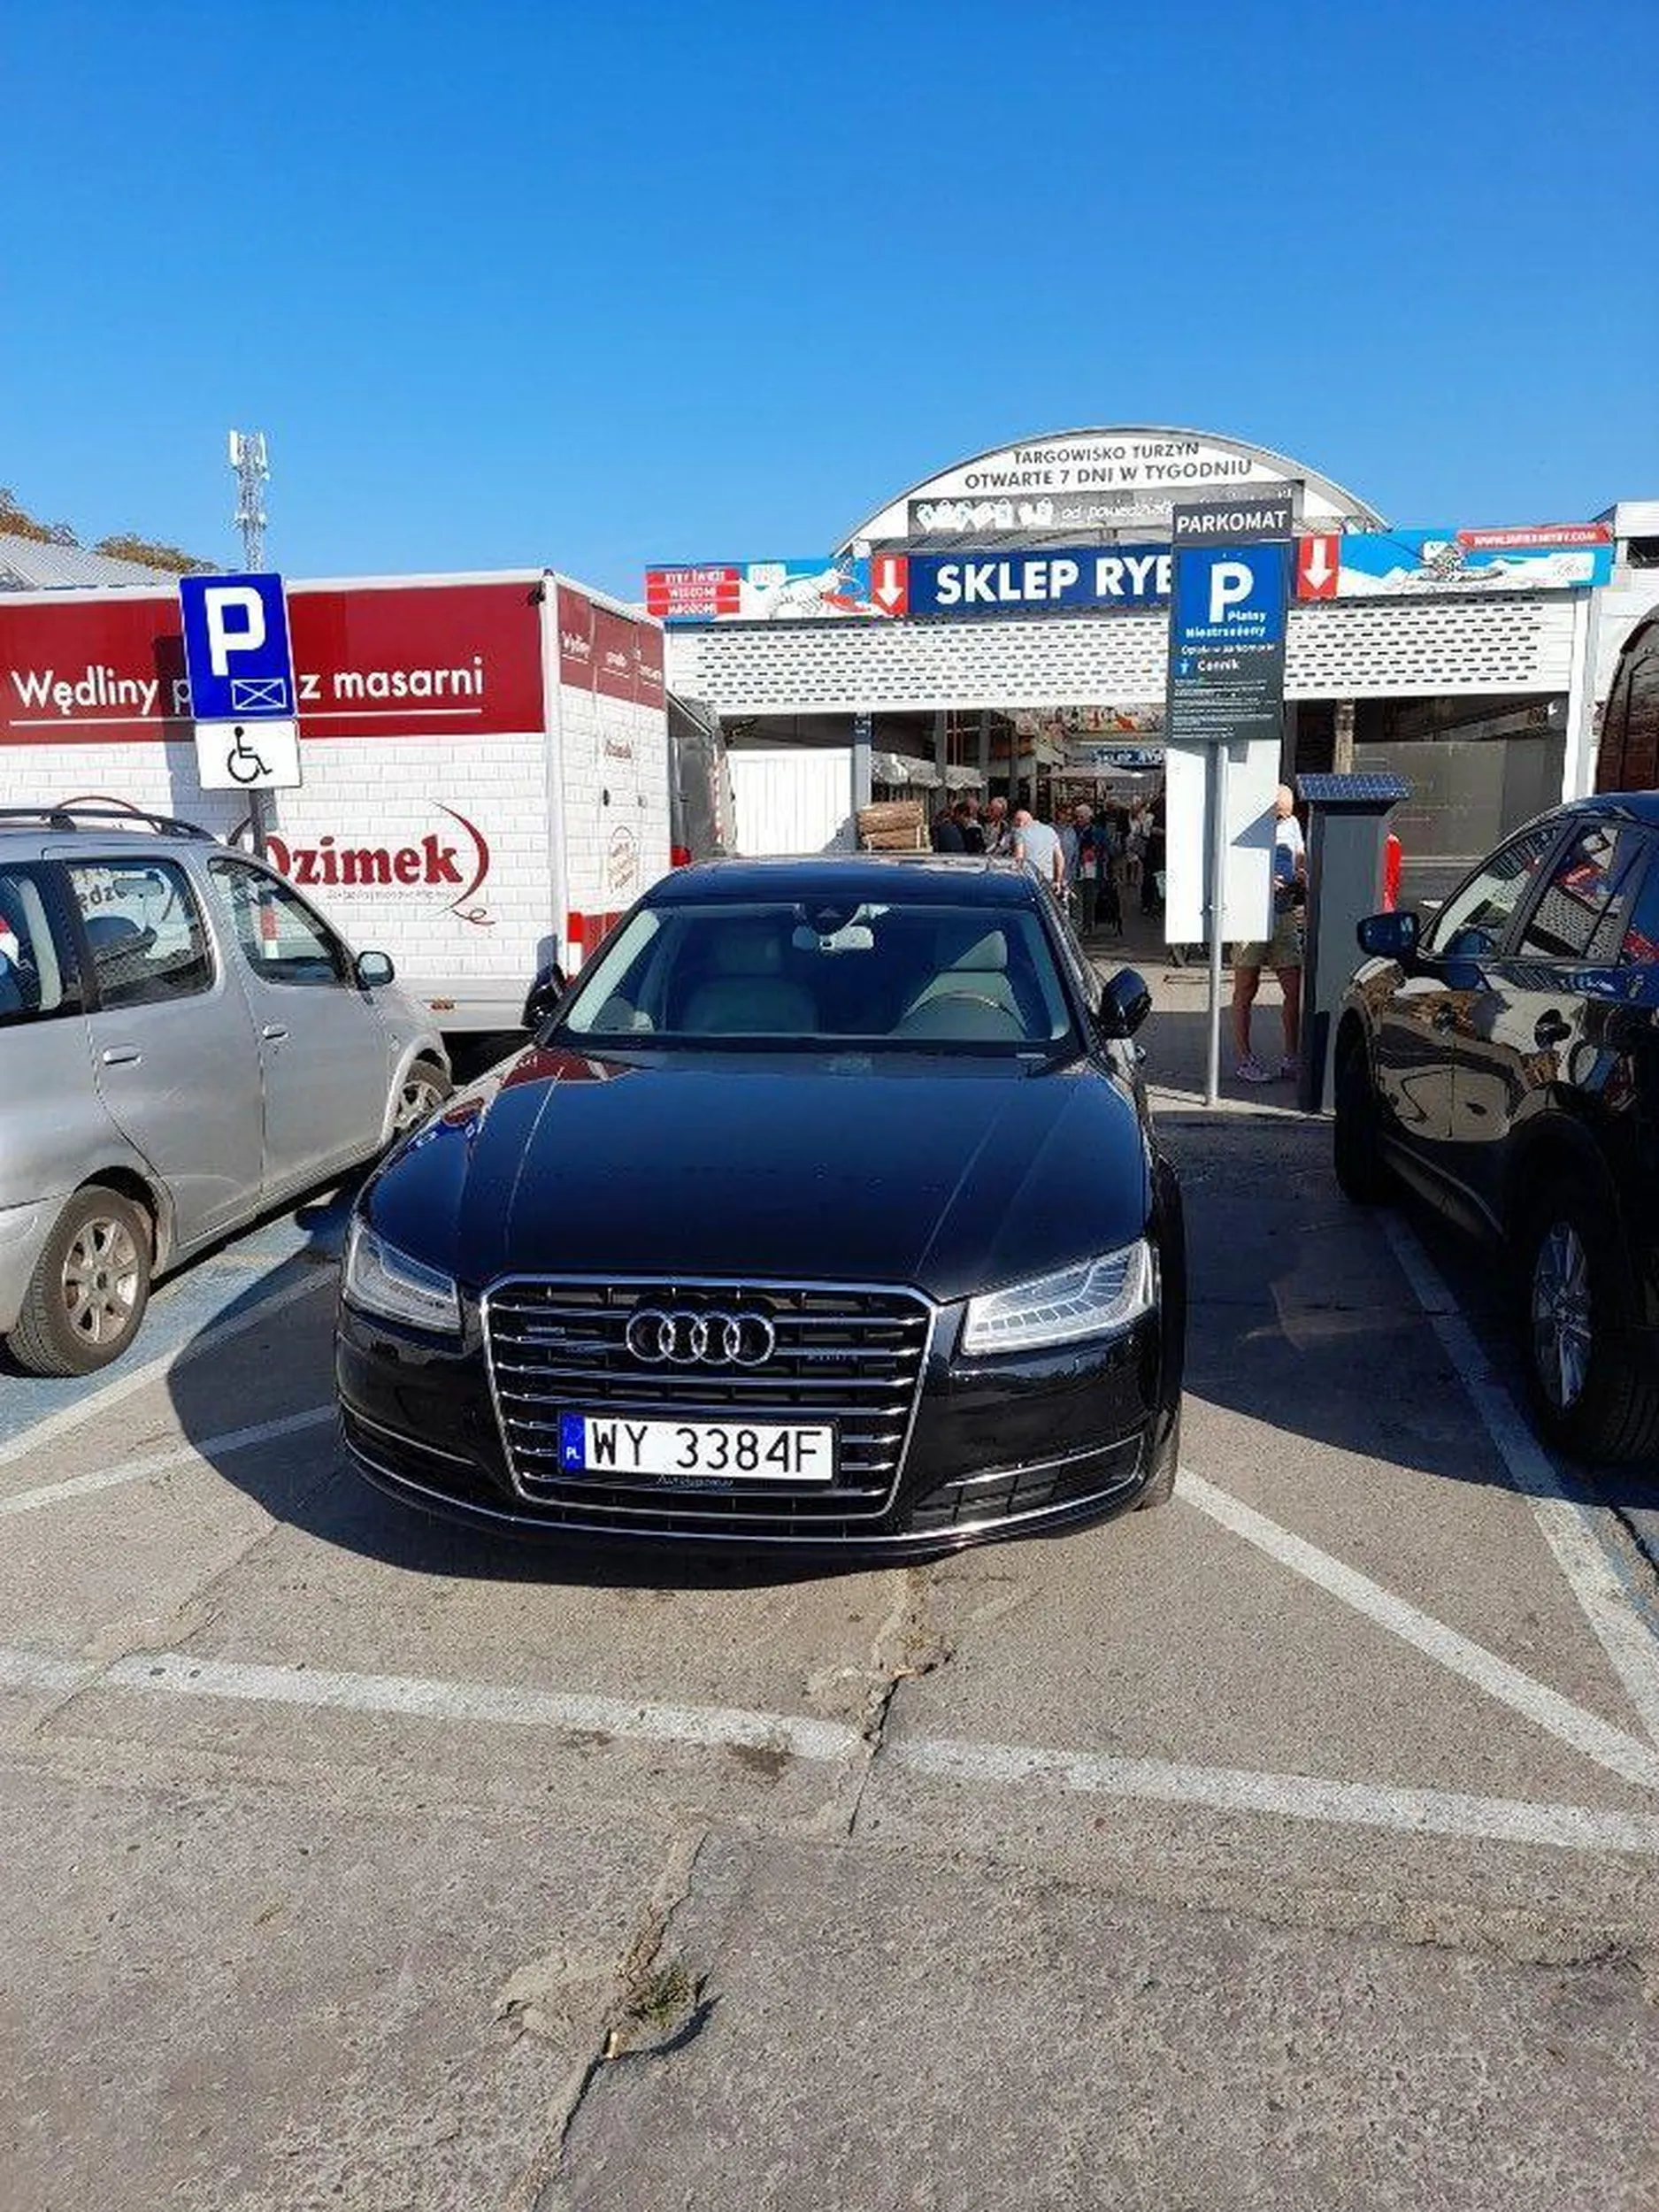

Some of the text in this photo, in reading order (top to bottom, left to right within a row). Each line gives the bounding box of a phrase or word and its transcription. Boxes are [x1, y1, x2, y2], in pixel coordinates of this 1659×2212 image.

[964, 458, 1253, 490] OTWARTE 7 DNI W TYGODNIU
[1014, 442, 1200, 465] TARGOWISKO TURZYN
[1177, 510, 1288, 534] PARKOMAT
[935, 558, 1079, 605] SKLEP
[1209, 561, 1255, 624] P
[204, 586, 266, 677] P
[11, 664, 160, 716] Wędliny
[299, 674, 322, 700] z
[333, 656, 483, 700] masarni
[565, 1446, 581, 1460] PL
[592, 1421, 823, 1473] WY 3384F
